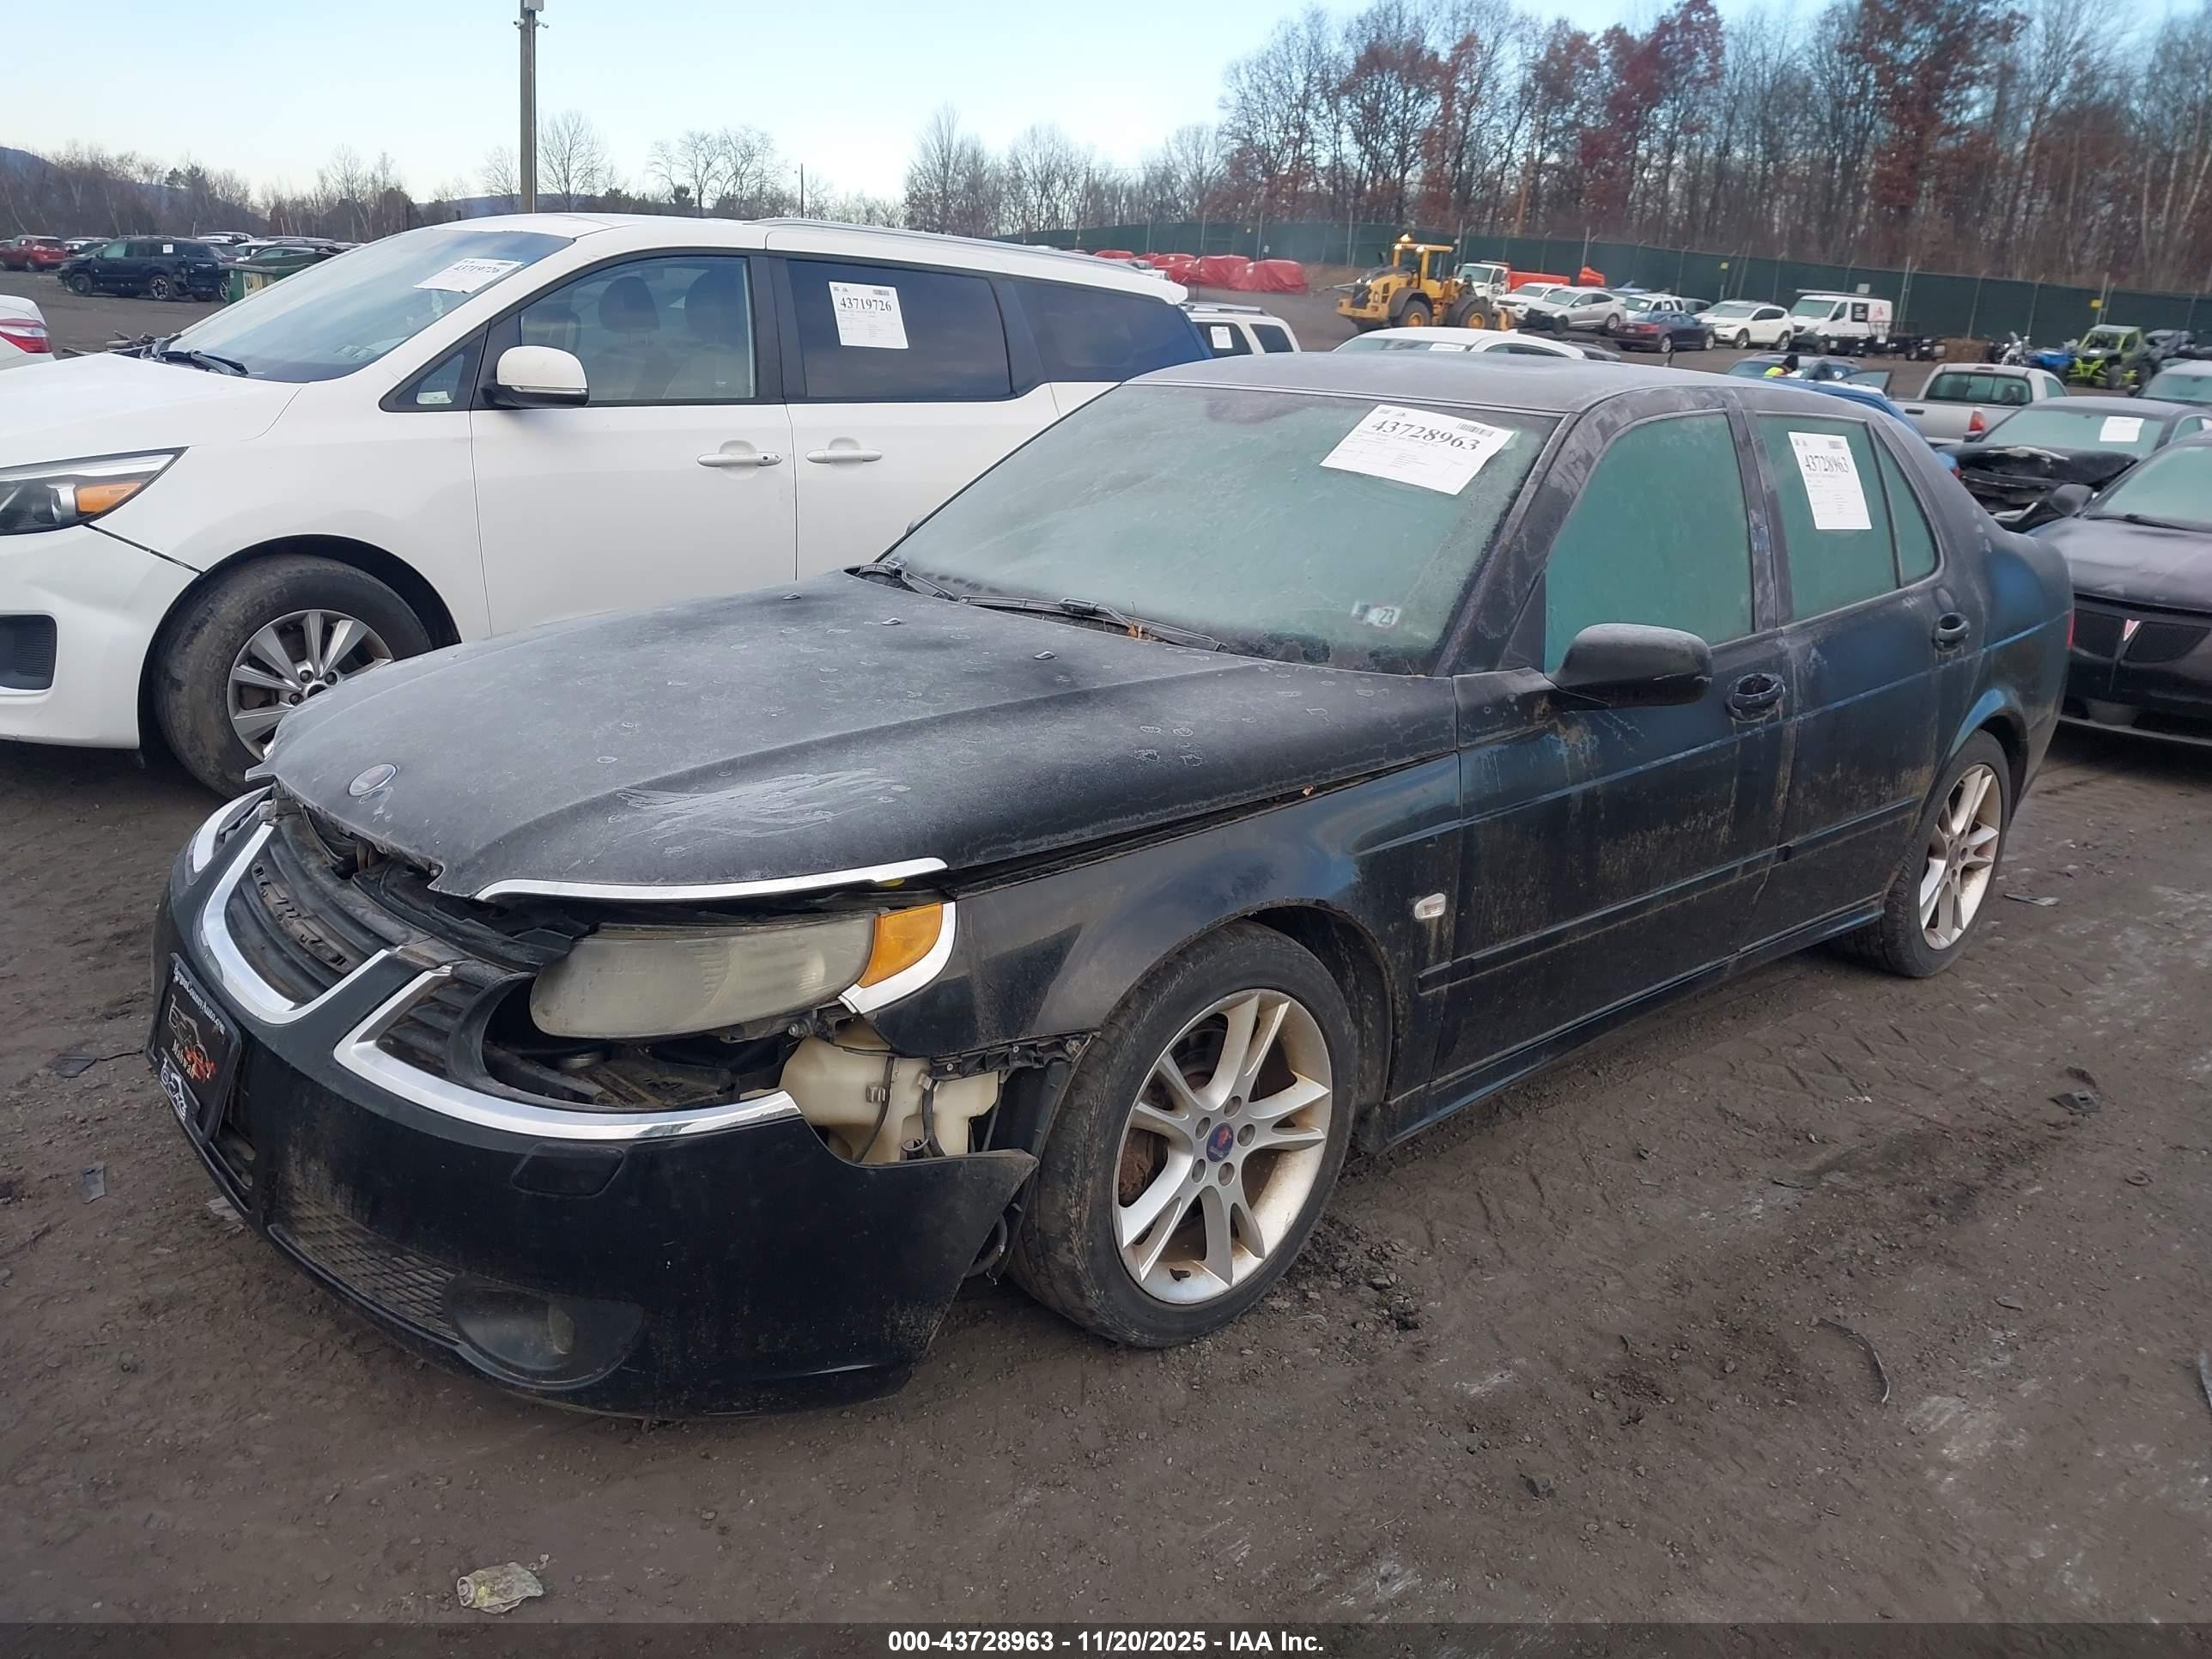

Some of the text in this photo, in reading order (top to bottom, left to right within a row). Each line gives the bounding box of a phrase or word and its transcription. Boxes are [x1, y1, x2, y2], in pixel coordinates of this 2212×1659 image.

[840, 297, 891, 311] 43719726
[1371, 420, 1480, 451] 43728963
[1805, 454, 1849, 472] 43728963
